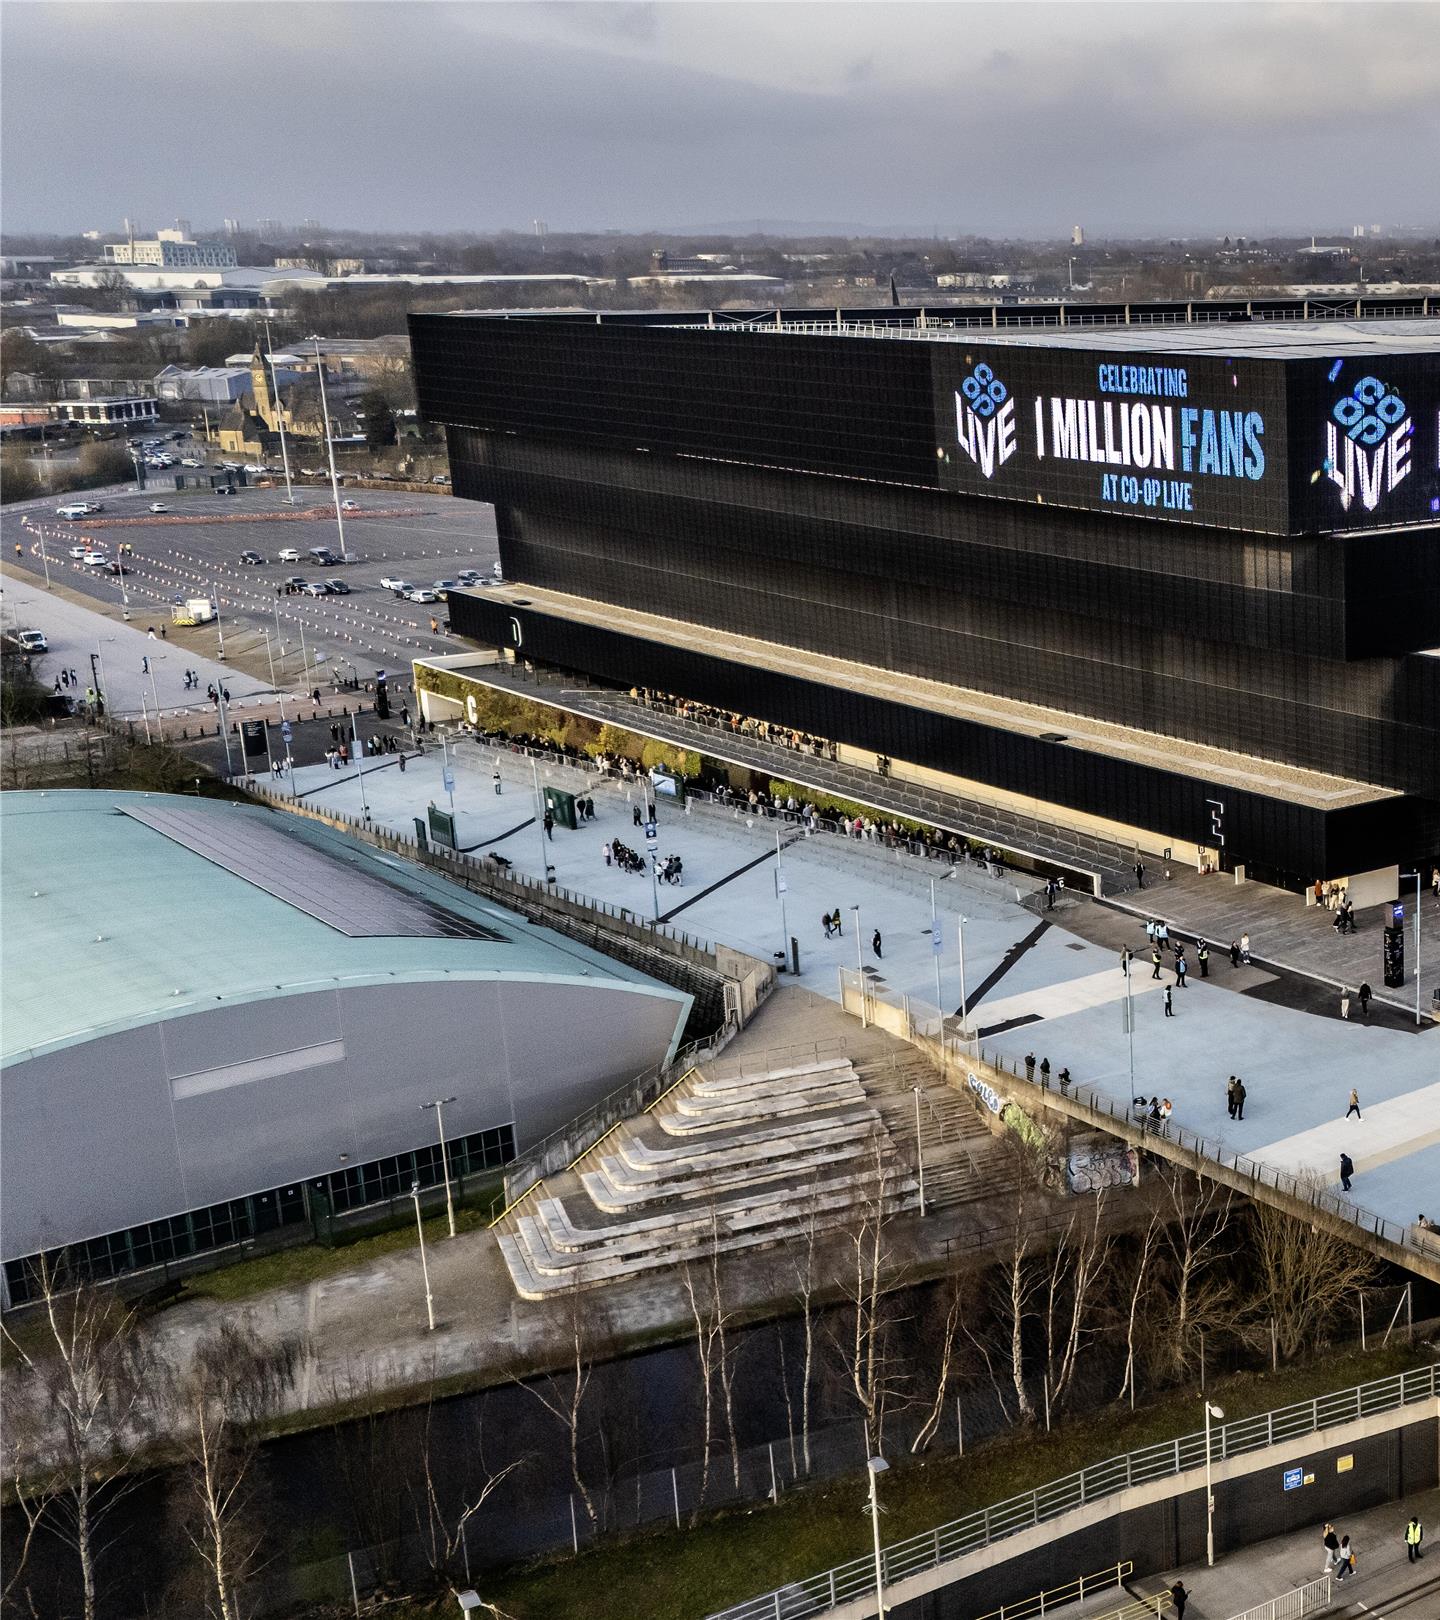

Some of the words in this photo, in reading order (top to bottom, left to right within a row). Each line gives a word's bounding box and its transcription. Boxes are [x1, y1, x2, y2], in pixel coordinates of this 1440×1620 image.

[1100, 364, 1188, 398] CELEBRATING
[954, 390, 1016, 479] LIVE
[1051, 397, 1174, 470] MILLION
[1181, 407, 1265, 480] FANS
[1327, 416, 1411, 511] LIVE
[1102, 474, 1119, 500] AT
[1122, 478, 1160, 507] CO-OP
[1163, 482, 1193, 511] LIVE
[467, 695, 478, 724] C
